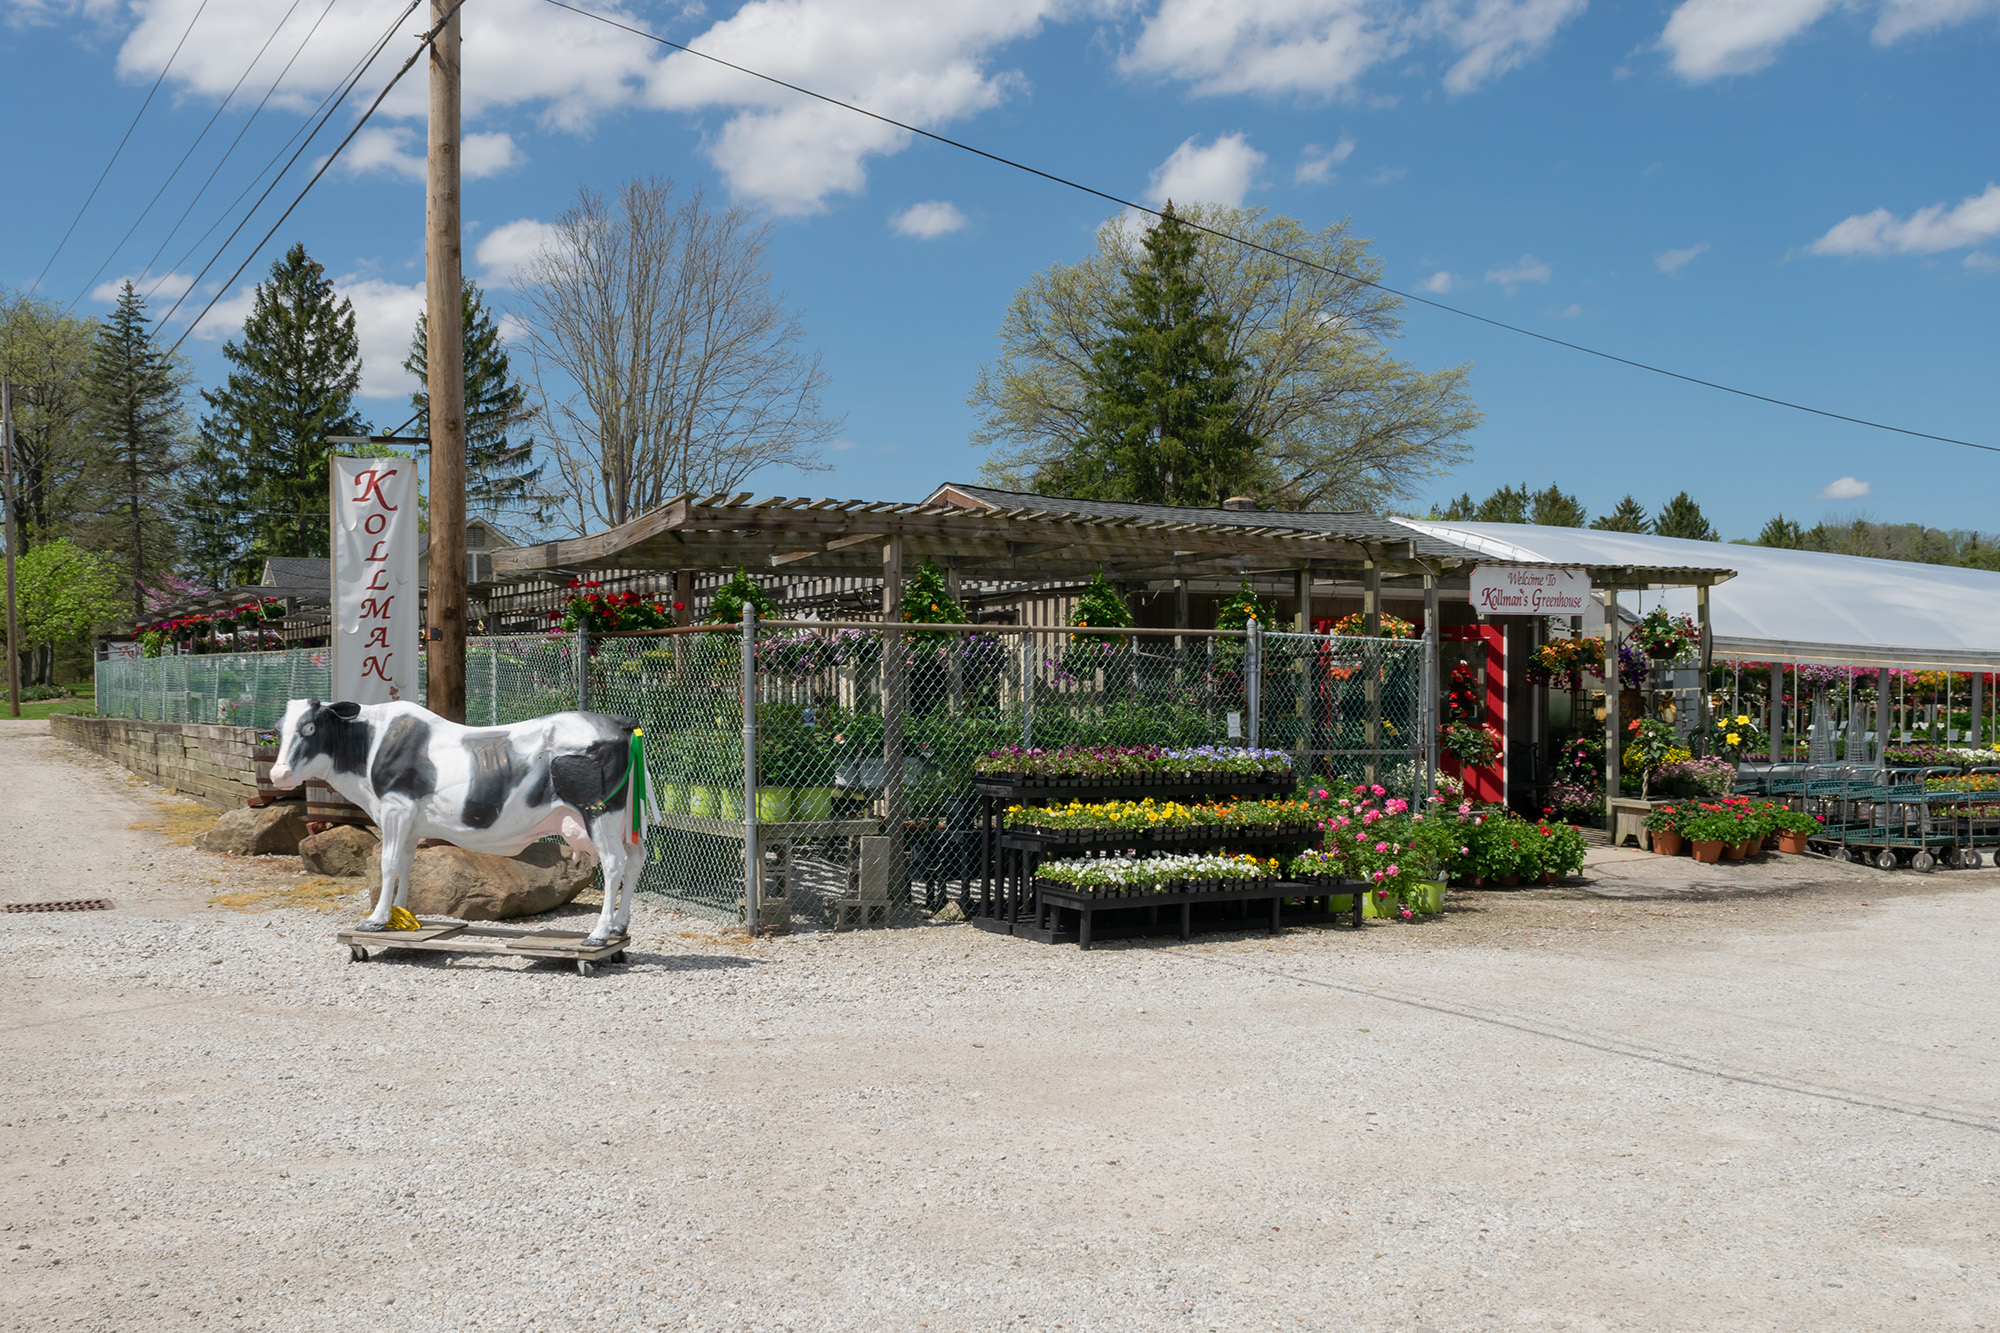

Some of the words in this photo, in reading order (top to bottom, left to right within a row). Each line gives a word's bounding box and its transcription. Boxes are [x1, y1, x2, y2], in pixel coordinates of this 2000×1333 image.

[352, 469, 398, 682] KOLLMAN
[1508, 571, 1544, 586] Welcome
[1545, 573, 1557, 587] To
[1481, 587, 1529, 610] Kollman's
[1532, 589, 1582, 612] Greenhouse
